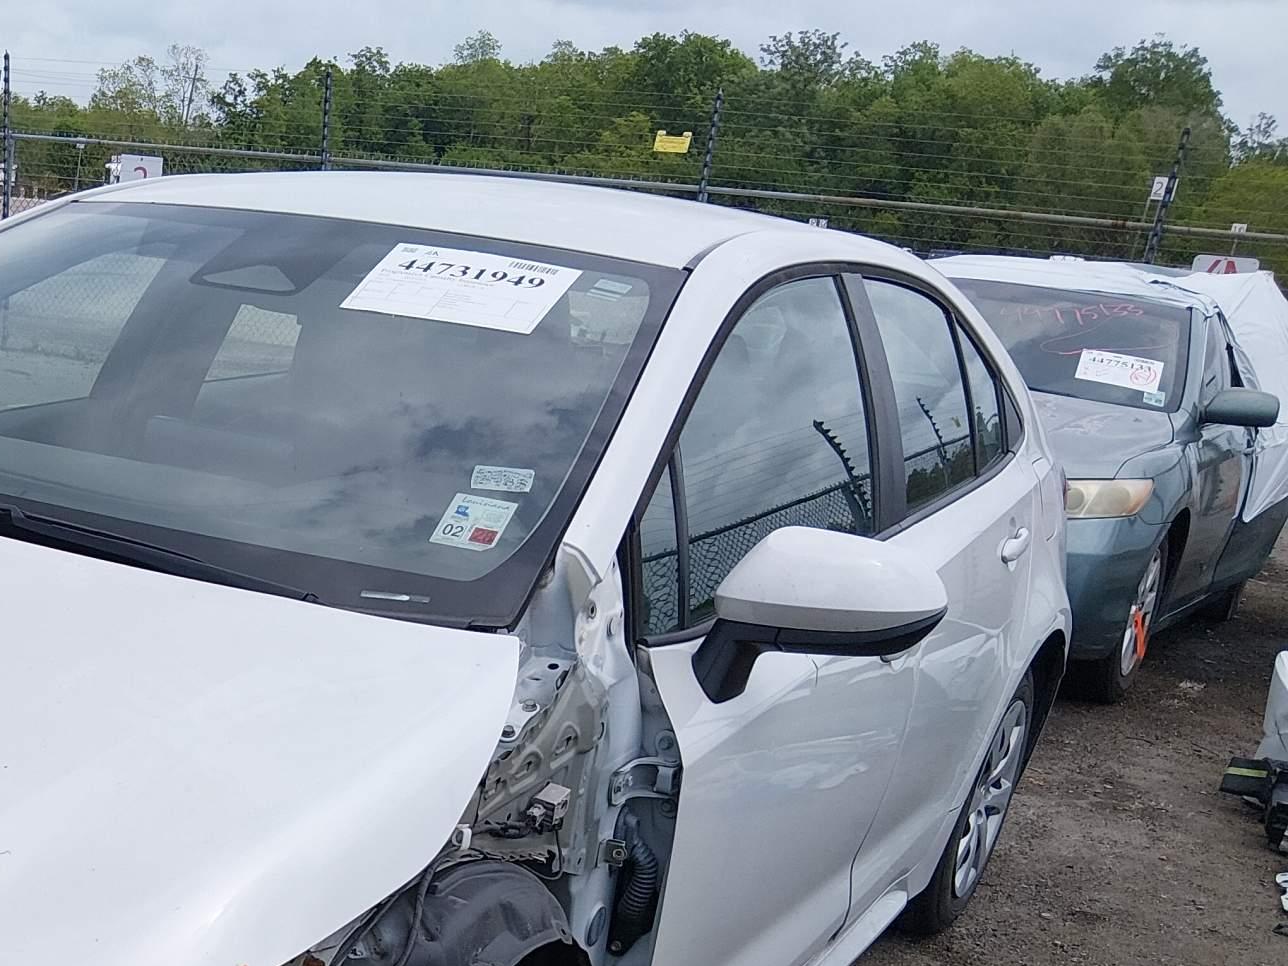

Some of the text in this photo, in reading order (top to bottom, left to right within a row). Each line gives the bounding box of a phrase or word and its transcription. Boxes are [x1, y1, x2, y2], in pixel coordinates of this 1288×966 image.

[1153, 181, 1163, 194] 2
[398, 258, 545, 289] 44731949
[442, 523, 464, 538] 02
